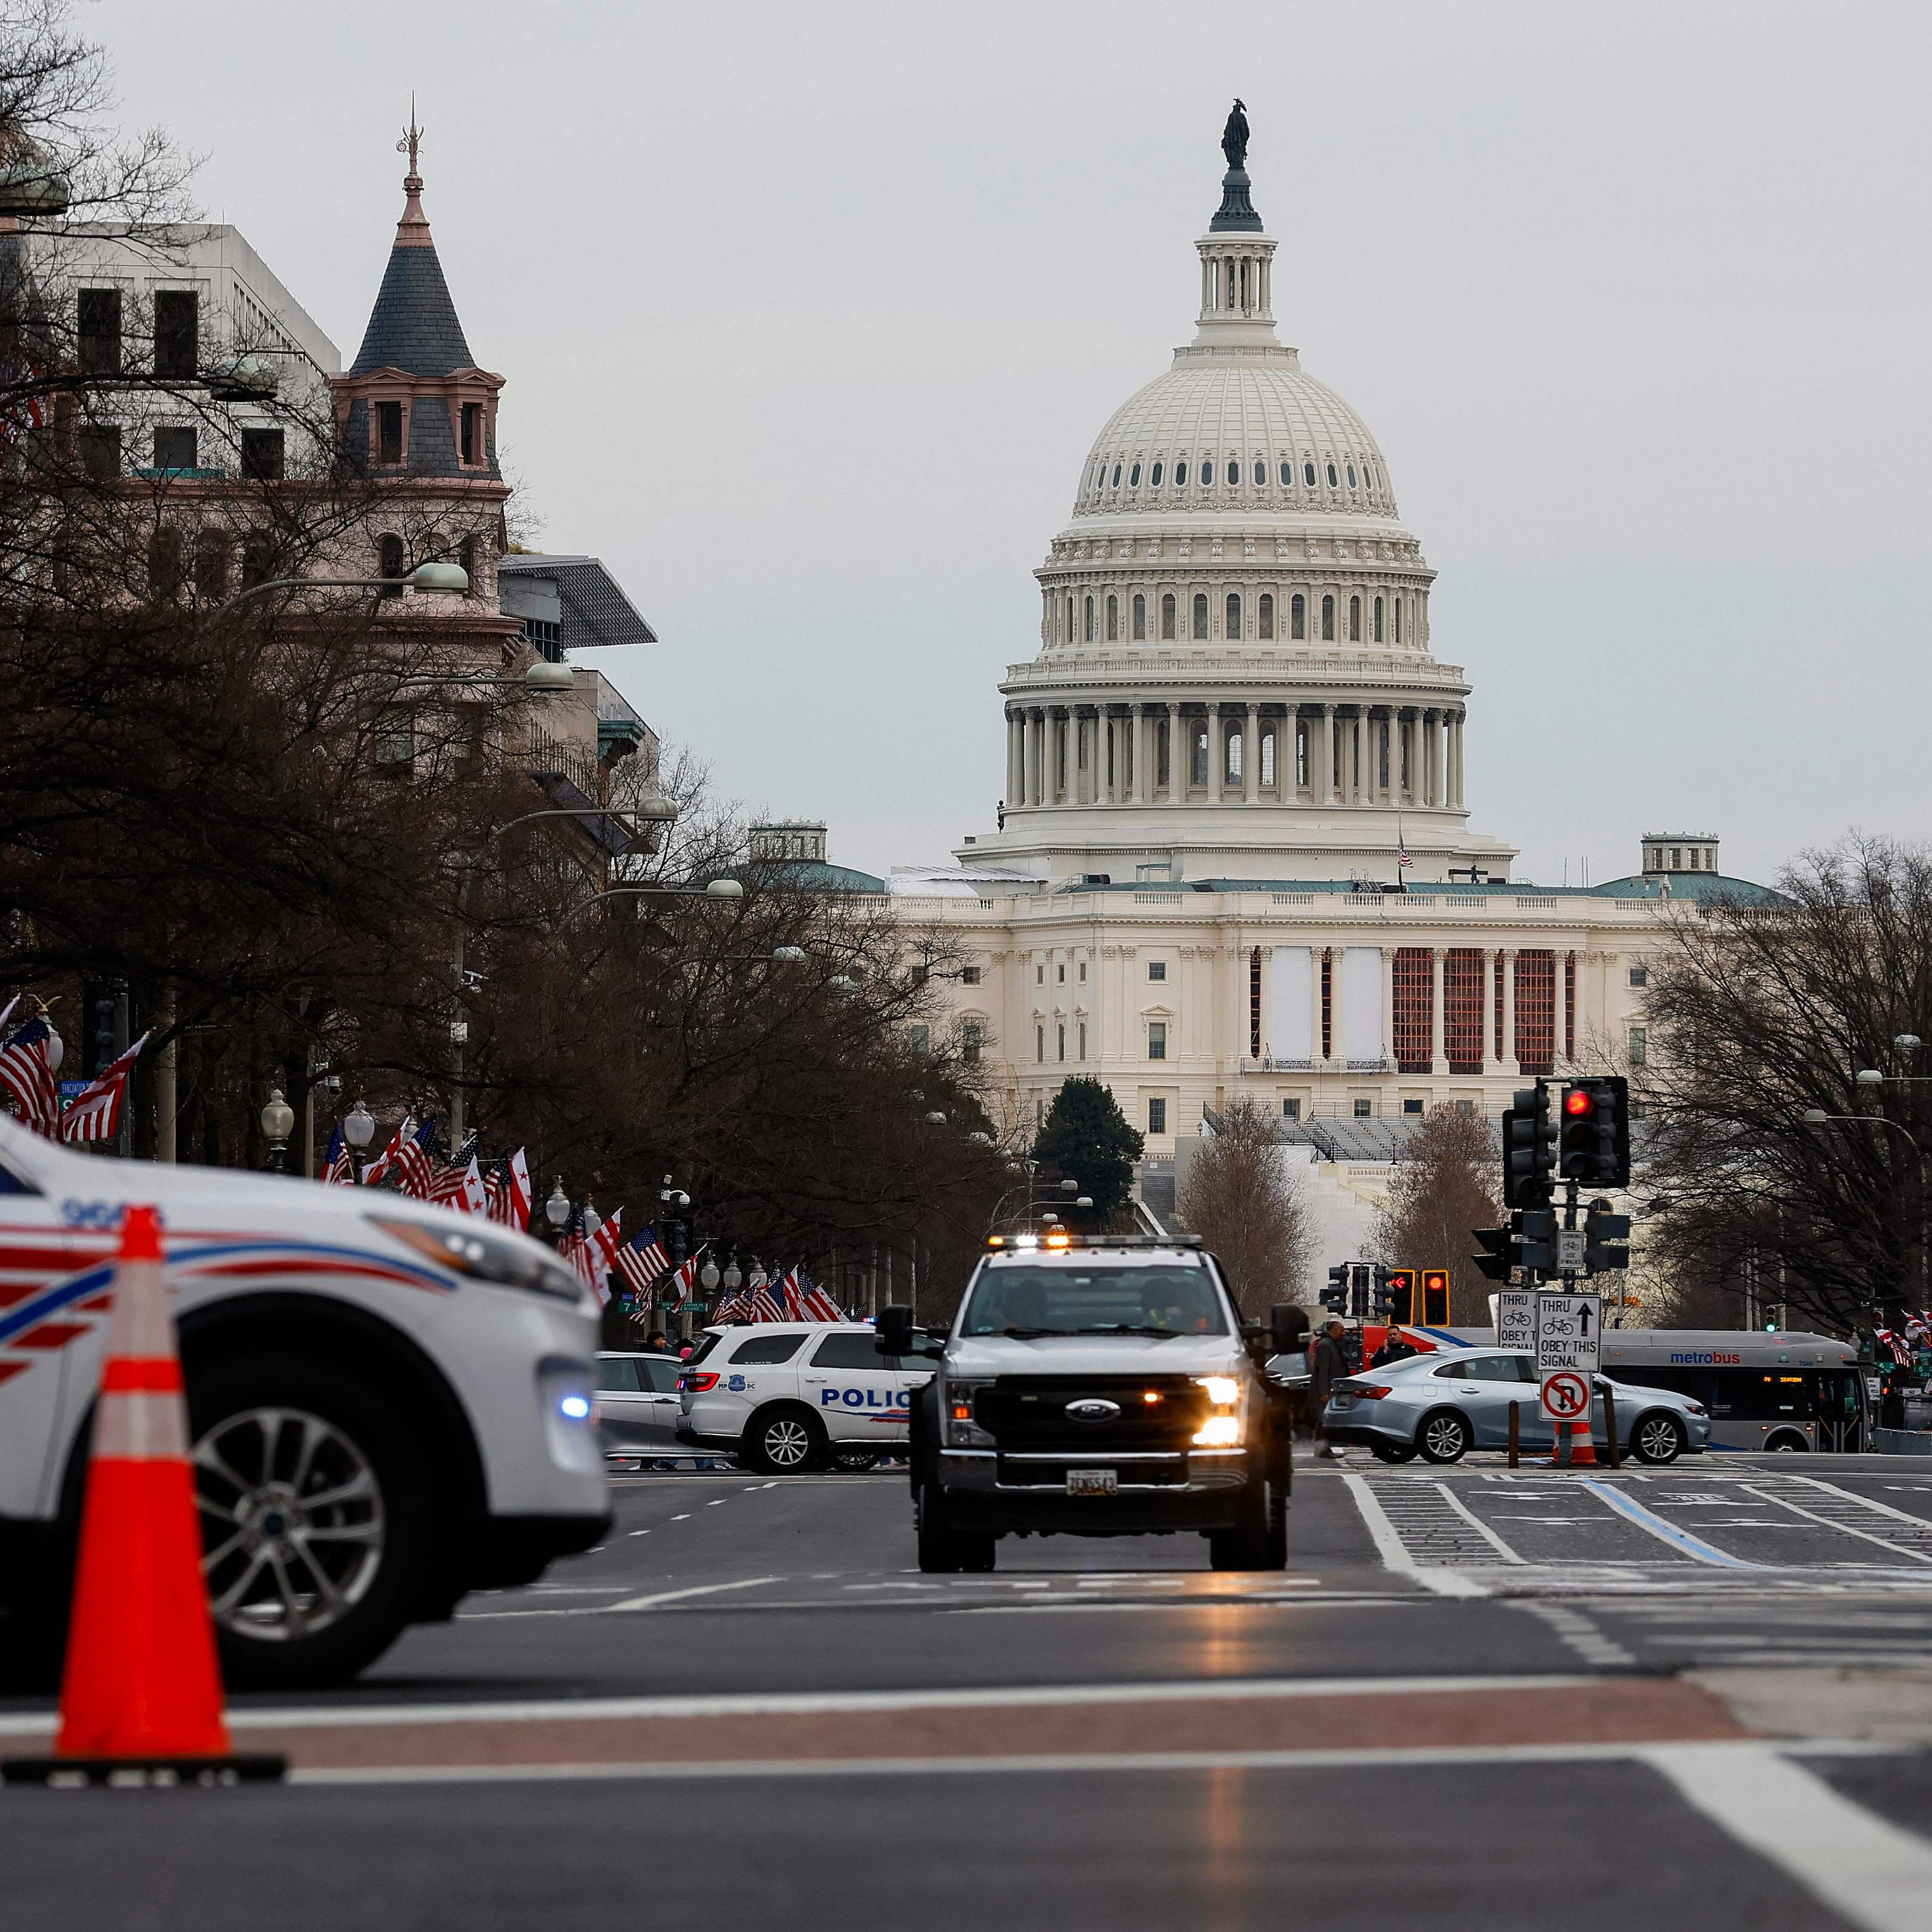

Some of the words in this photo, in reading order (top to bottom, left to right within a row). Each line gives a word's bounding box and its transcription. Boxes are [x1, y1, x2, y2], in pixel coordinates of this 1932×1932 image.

[1503, 1295, 1528, 1306] THRU
[1542, 1300, 1571, 1312] THRU
[1502, 1330, 1527, 1341] OBEY
[1541, 1340, 1568, 1352] OBEY
[1573, 1341, 1596, 1353] THIS
[1541, 1355, 1579, 1367] SIGNAL
[1670, 1352, 1740, 1364] metrobus
[822, 1389, 910, 1408] POLIC
